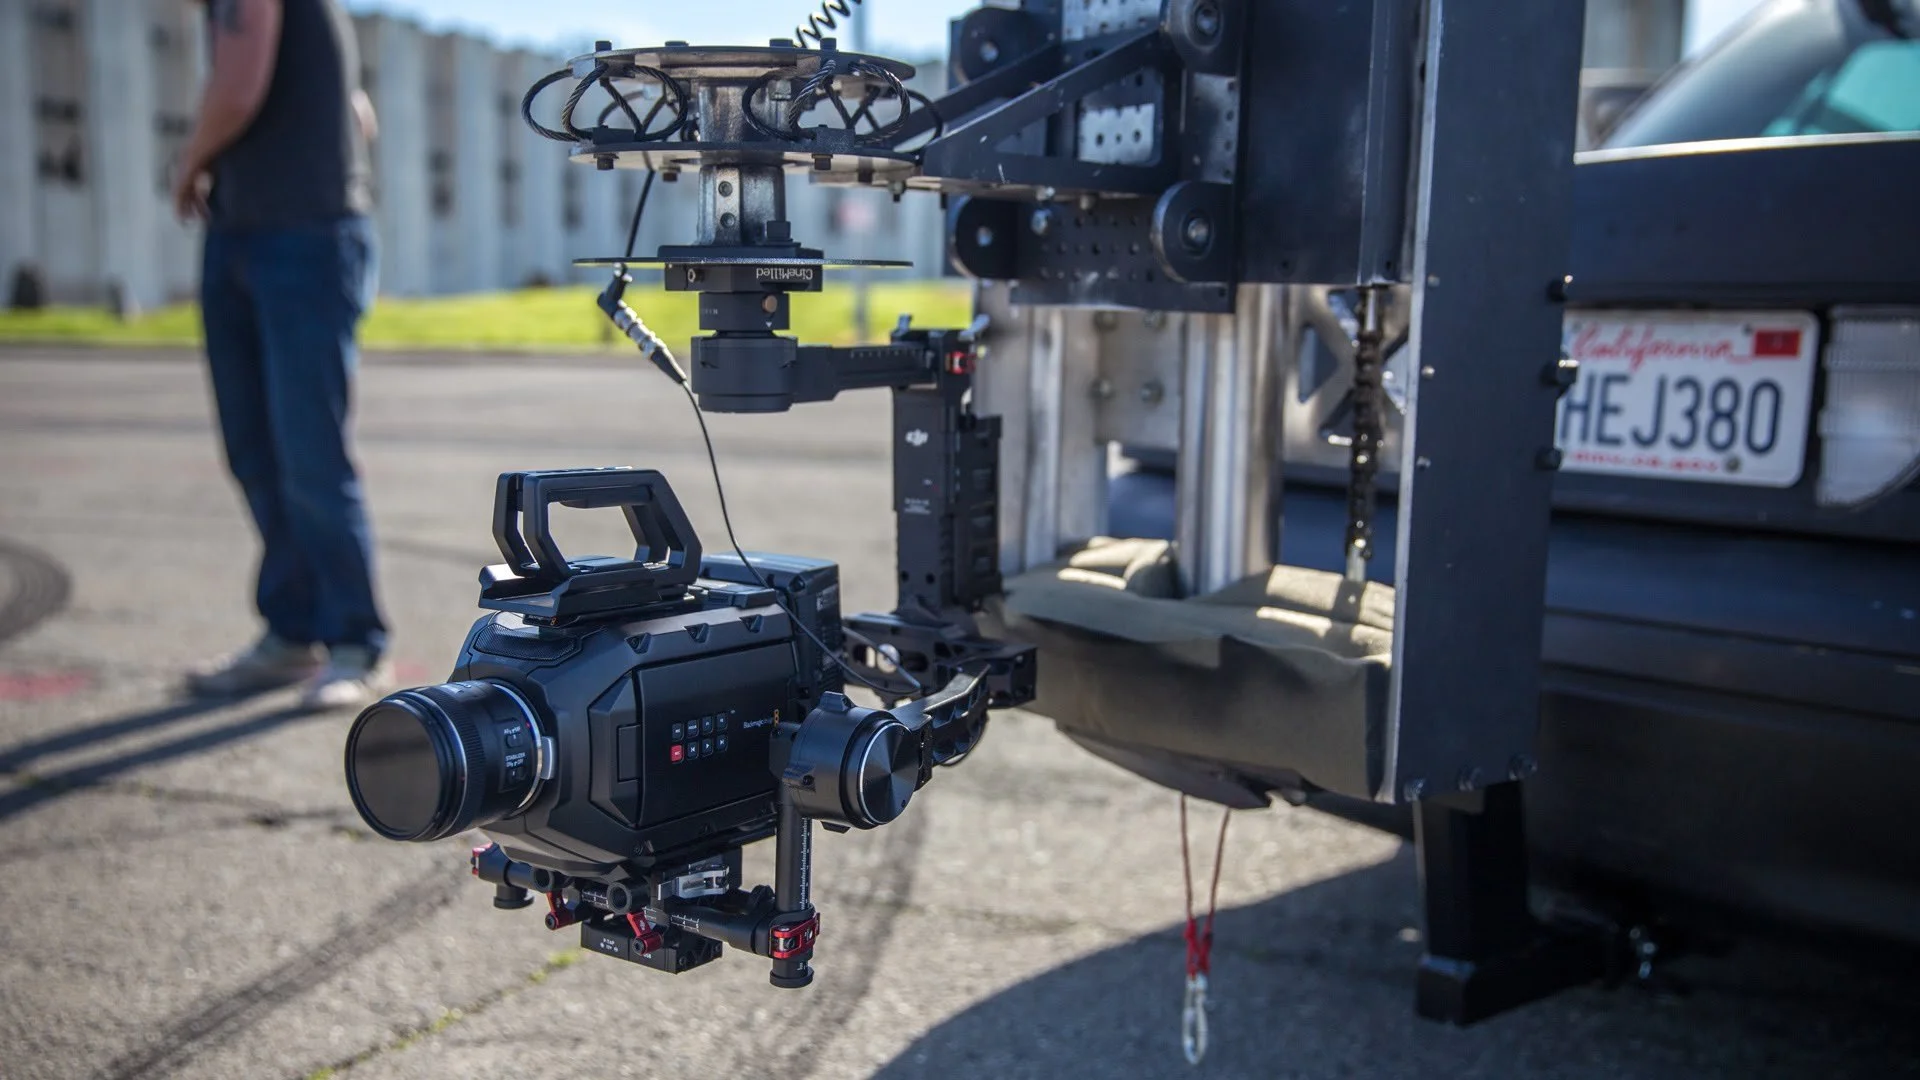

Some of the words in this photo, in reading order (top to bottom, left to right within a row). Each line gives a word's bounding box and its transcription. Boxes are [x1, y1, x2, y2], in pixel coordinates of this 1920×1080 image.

[755, 267, 814, 280] CineMilled
[1573, 323, 1751, 372] California
[1560, 372, 1784, 457] HEJ380
